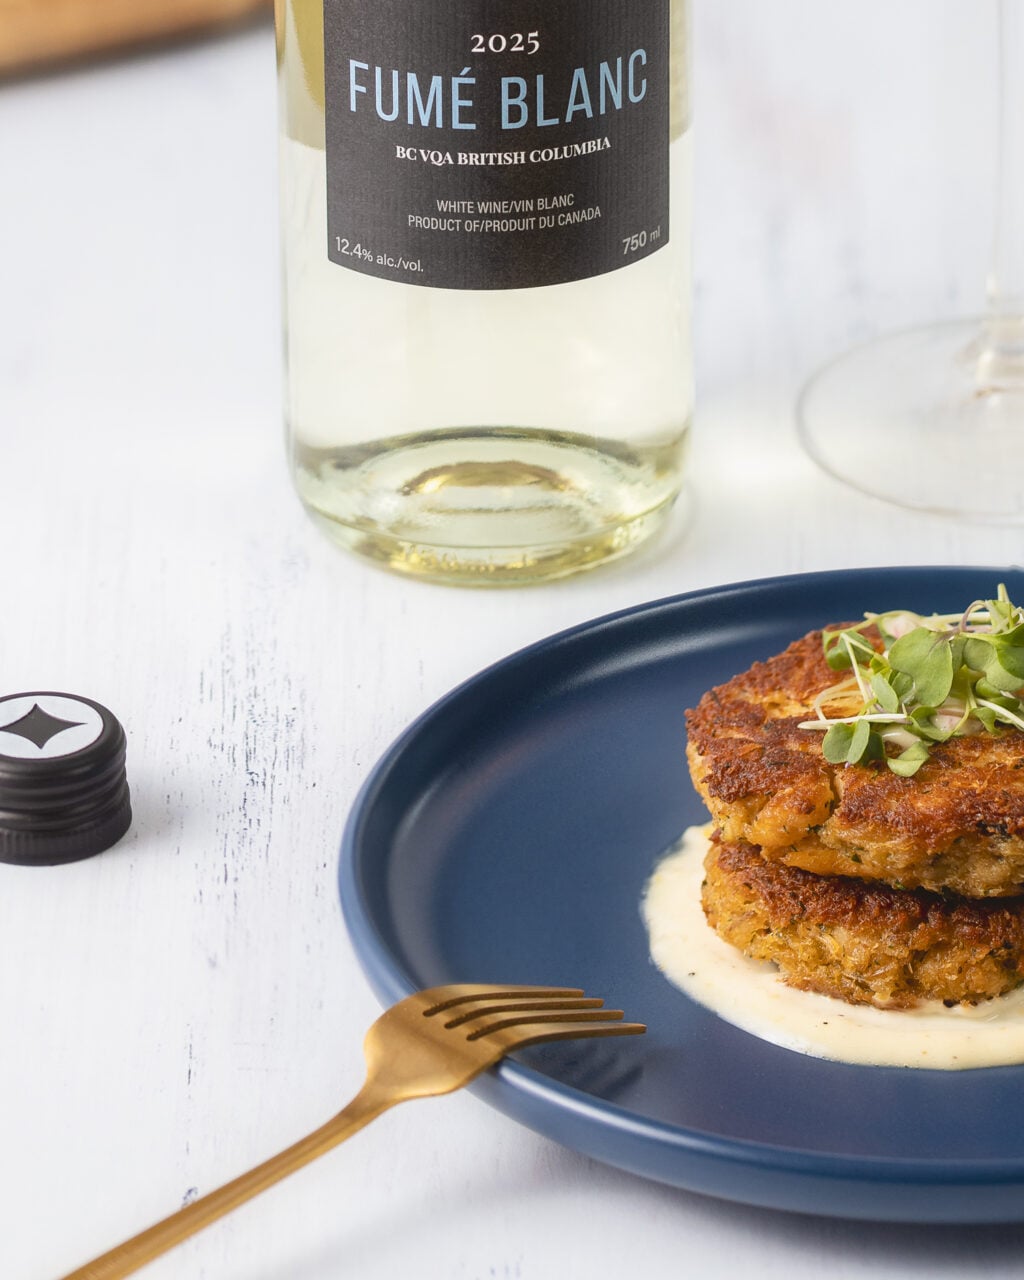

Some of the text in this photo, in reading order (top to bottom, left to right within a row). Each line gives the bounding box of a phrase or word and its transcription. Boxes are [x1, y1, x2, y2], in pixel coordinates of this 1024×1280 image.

[470, 30, 540, 55] 2025
[349, 48, 647, 130] FUMÉ BLANC
[395, 136, 612, 167] BC VQA BRITISH COLUMBIA
[408, 205, 602, 233] PRODUCT OF/PRODUIT DU CANADA
[436, 193, 575, 215] WHITE WINE/VIN BLANC
[335, 236, 424, 272] 12.4% alc./vol.
[622, 225, 661, 255] 750 ml
